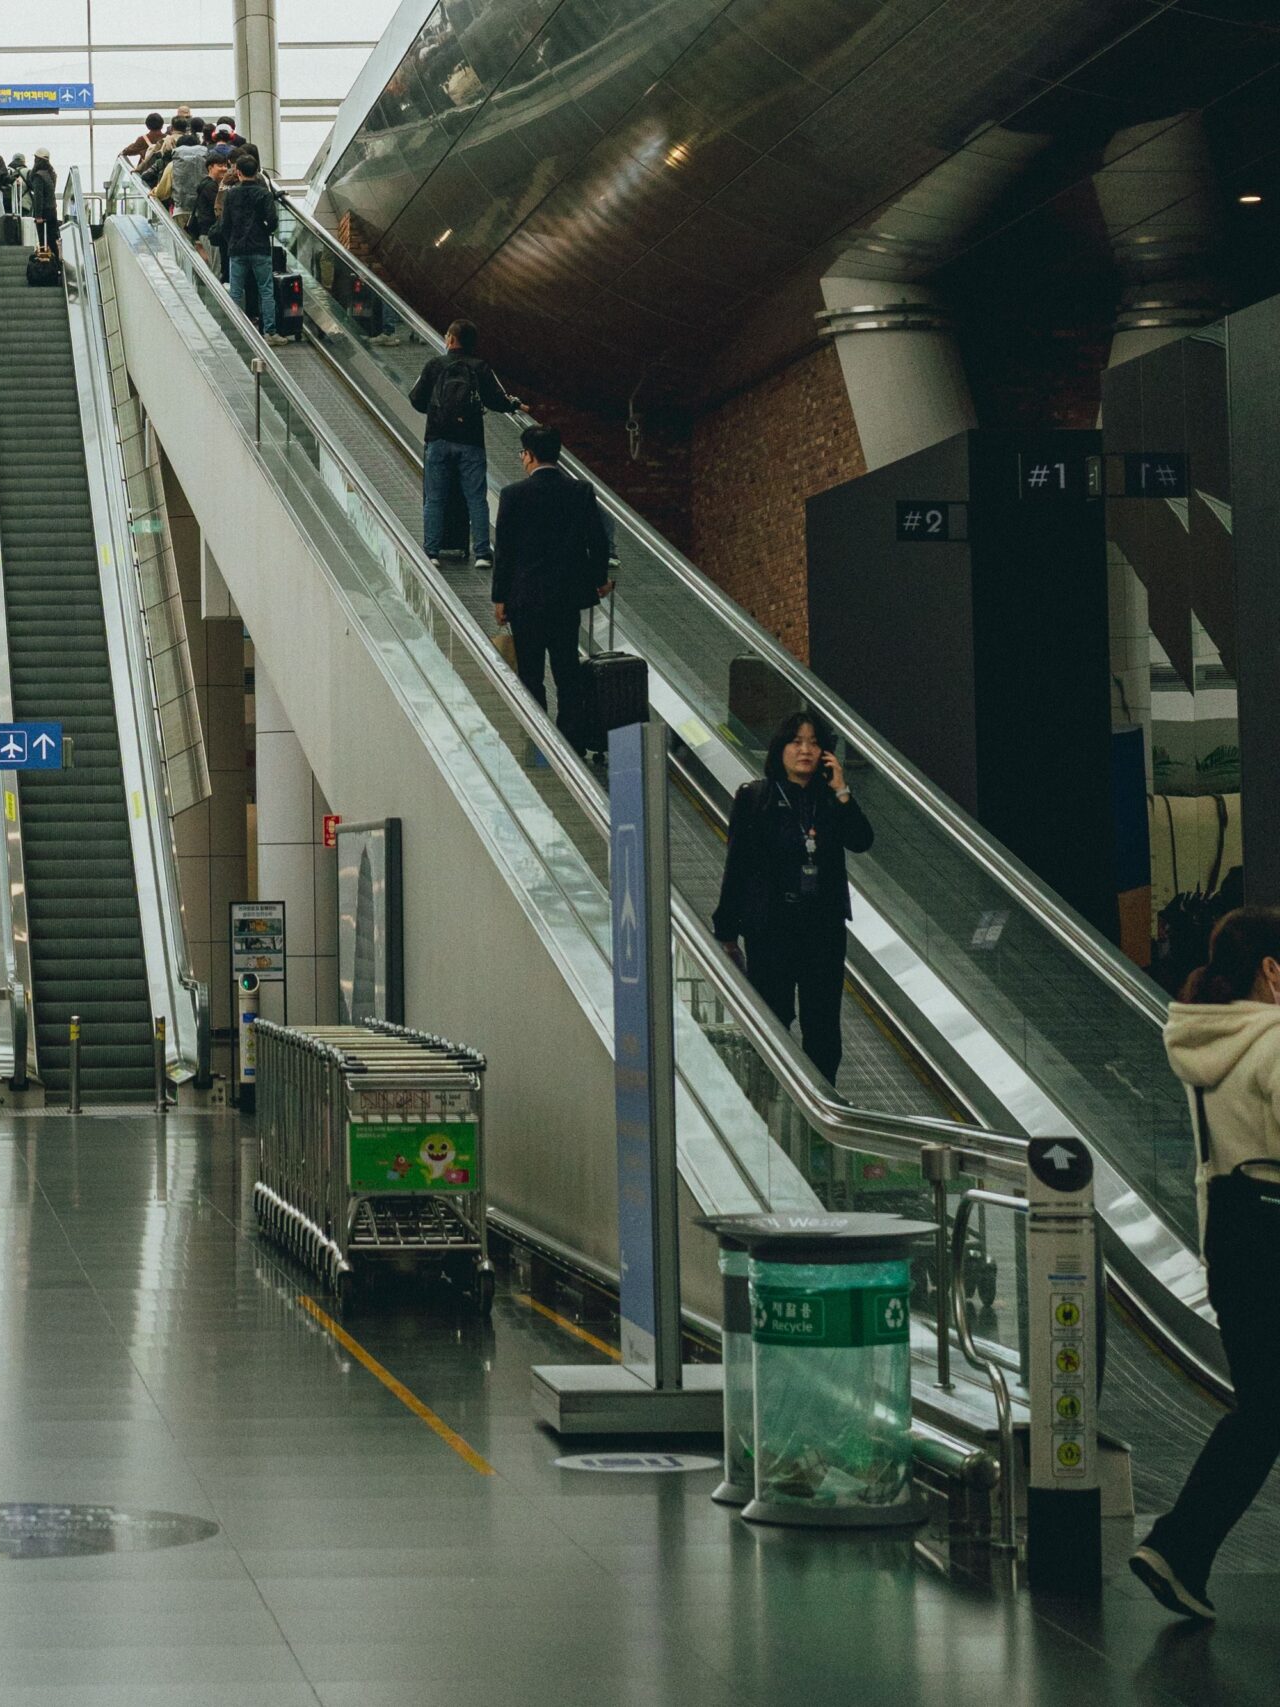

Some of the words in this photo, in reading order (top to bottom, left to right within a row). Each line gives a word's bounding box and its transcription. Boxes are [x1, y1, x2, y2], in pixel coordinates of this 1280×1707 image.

[1028, 463, 1065, 489] #1
[903, 509, 943, 533] #2
[788, 1216, 849, 1229] Waste
[772, 1319, 813, 1334] Recycle
